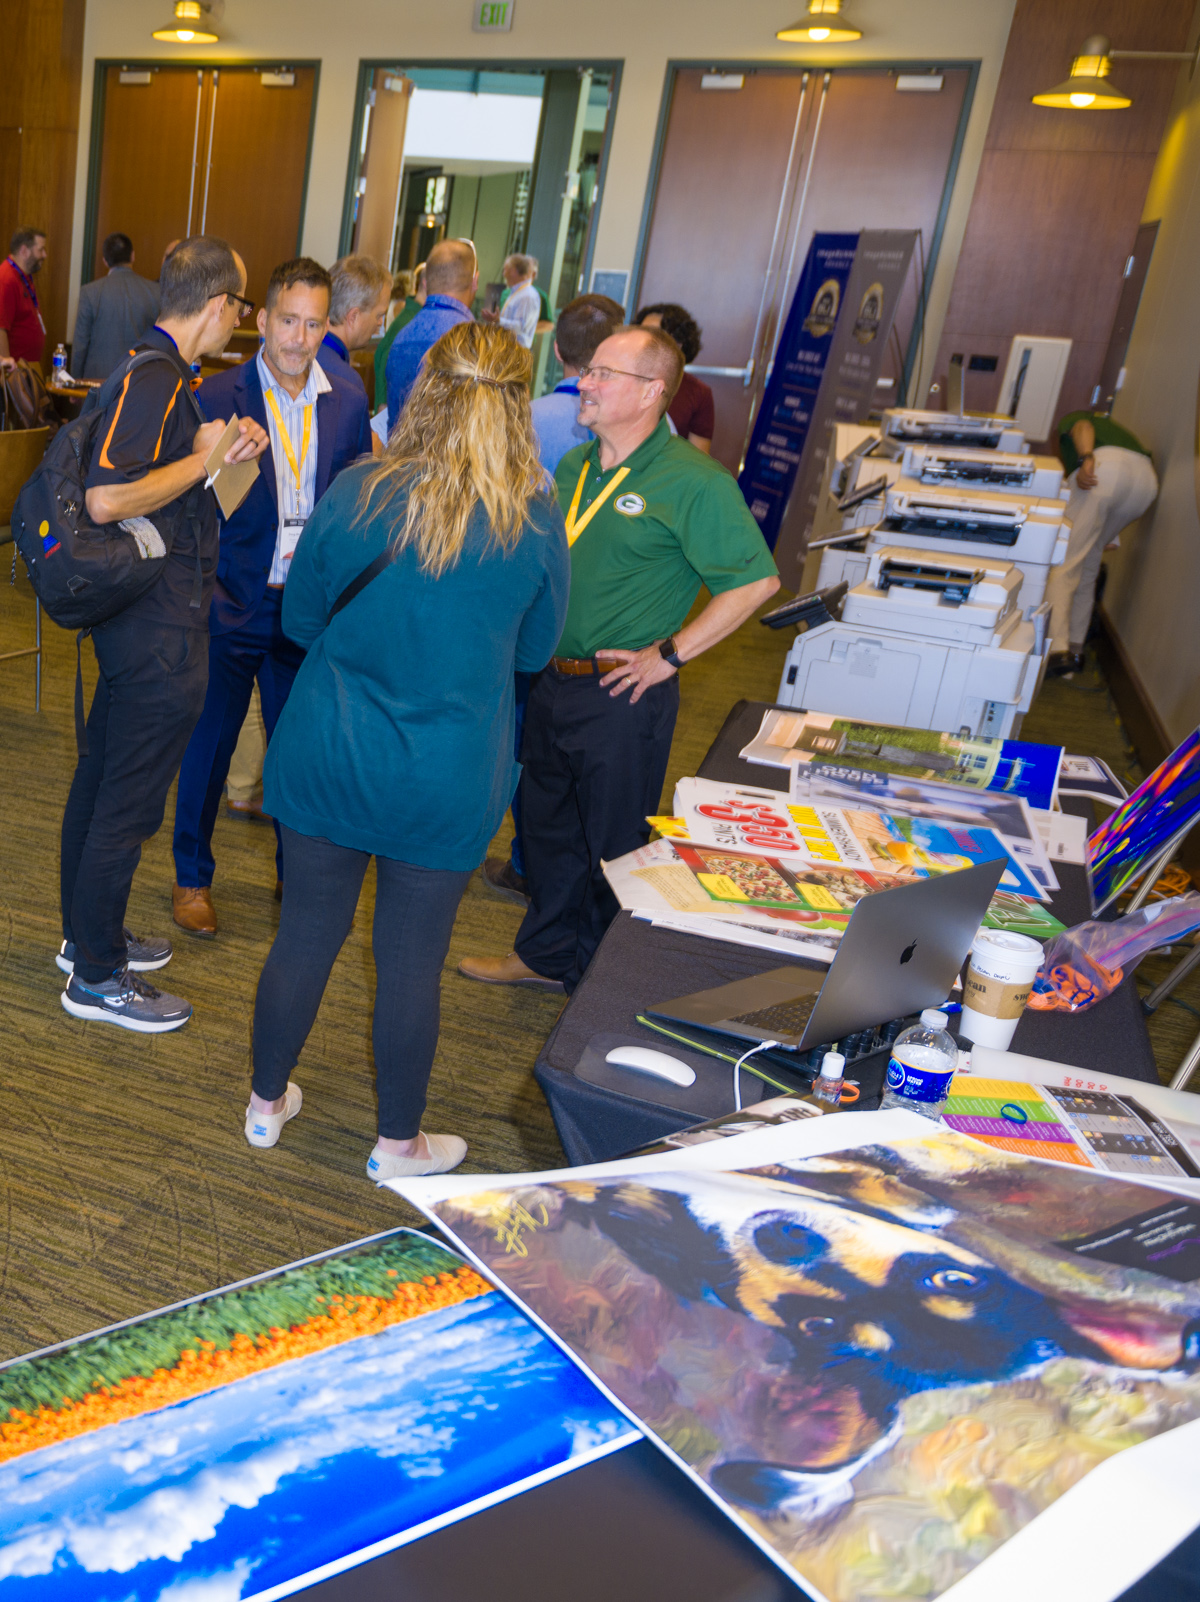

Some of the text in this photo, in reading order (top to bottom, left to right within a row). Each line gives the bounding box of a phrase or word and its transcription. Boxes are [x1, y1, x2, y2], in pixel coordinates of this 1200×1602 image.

[479, 2, 508, 25] EXIT
[786, 803, 824, 828] NOW
[711, 822, 738, 845] PINTS
[796, 825, 831, 840] ON
[822, 811, 864, 862] SUMMER SHANDY
[804, 838, 843, 863] TAP!
